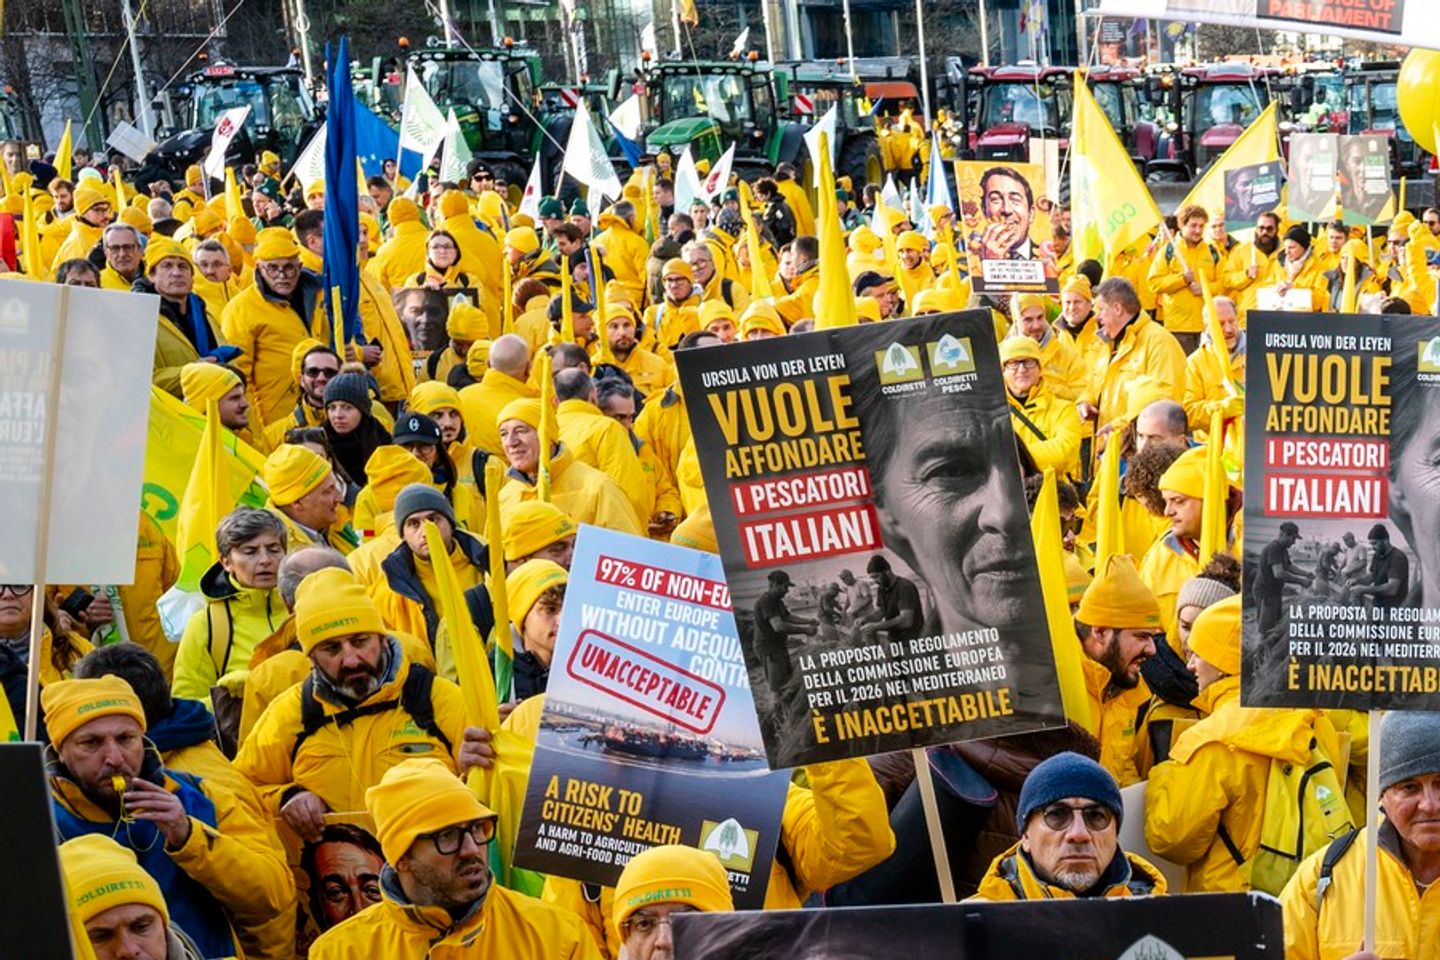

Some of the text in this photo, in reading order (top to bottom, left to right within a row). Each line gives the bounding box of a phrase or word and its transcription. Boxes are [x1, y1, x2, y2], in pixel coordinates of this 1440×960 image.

[1268, 0, 1391, 29] PARLIAMENT
[1265, 333, 1392, 352] URSULA VON DER LEYEN
[702, 353, 845, 388] URSULA VON DER LEYEN
[881, 373, 978, 395] COLDIRETTI COLDIRETTI
[941, 383, 973, 394] PESCA
[1265, 352, 1393, 406] VUOLE
[707, 374, 859, 446] VUOLE
[1265, 404, 1391, 435] AFFONDARE
[725, 430, 866, 479] AFFONDARE
[1268, 440, 1386, 468] I PESCATORI
[734, 470, 868, 513] I PESCATORI
[1269, 477, 1381, 514] ITALIANI
[745, 509, 874, 562] ITALIANI
[600, 558, 637, 587] 97%
[641, 567, 666, 592] OF
[581, 604, 669, 646] WITHOUT
[616, 591, 720, 631] ENTER EUROPE
[1289, 605, 1304, 620] LA
[1308, 605, 1368, 621] PROPOSTA
[1372, 607, 1384, 622] DI
[799, 627, 1000, 672] LA PROPOSTA DI REGOLAMENTO
[1289, 623, 1325, 639] DELLA
[1328, 623, 1413, 640] COMMISSIONE
[1289, 641, 1311, 656] PER
[1314, 642, 1325, 656] IL
[1328, 642, 1357, 657] 2026
[1360, 642, 1381, 657] NEL
[580, 643, 713, 721] UNACCEPTABLE
[803, 646, 1004, 690] DELLA COMMISSIONE EUROPEA
[808, 664, 1007, 709] PER IL 2026 NEL MEDITERRANEO
[1287, 656, 1300, 690] È
[811, 687, 1014, 744] È INACCETTABILE
[545, 775, 643, 816] A RISK TO
[537, 823, 547, 836] A
[548, 825, 578, 840] HARM
[580, 831, 593, 846] TO
[542, 800, 682, 846] CITIZENS' HEALTH
[535, 837, 613, 865] AND AGRI-FOOD
